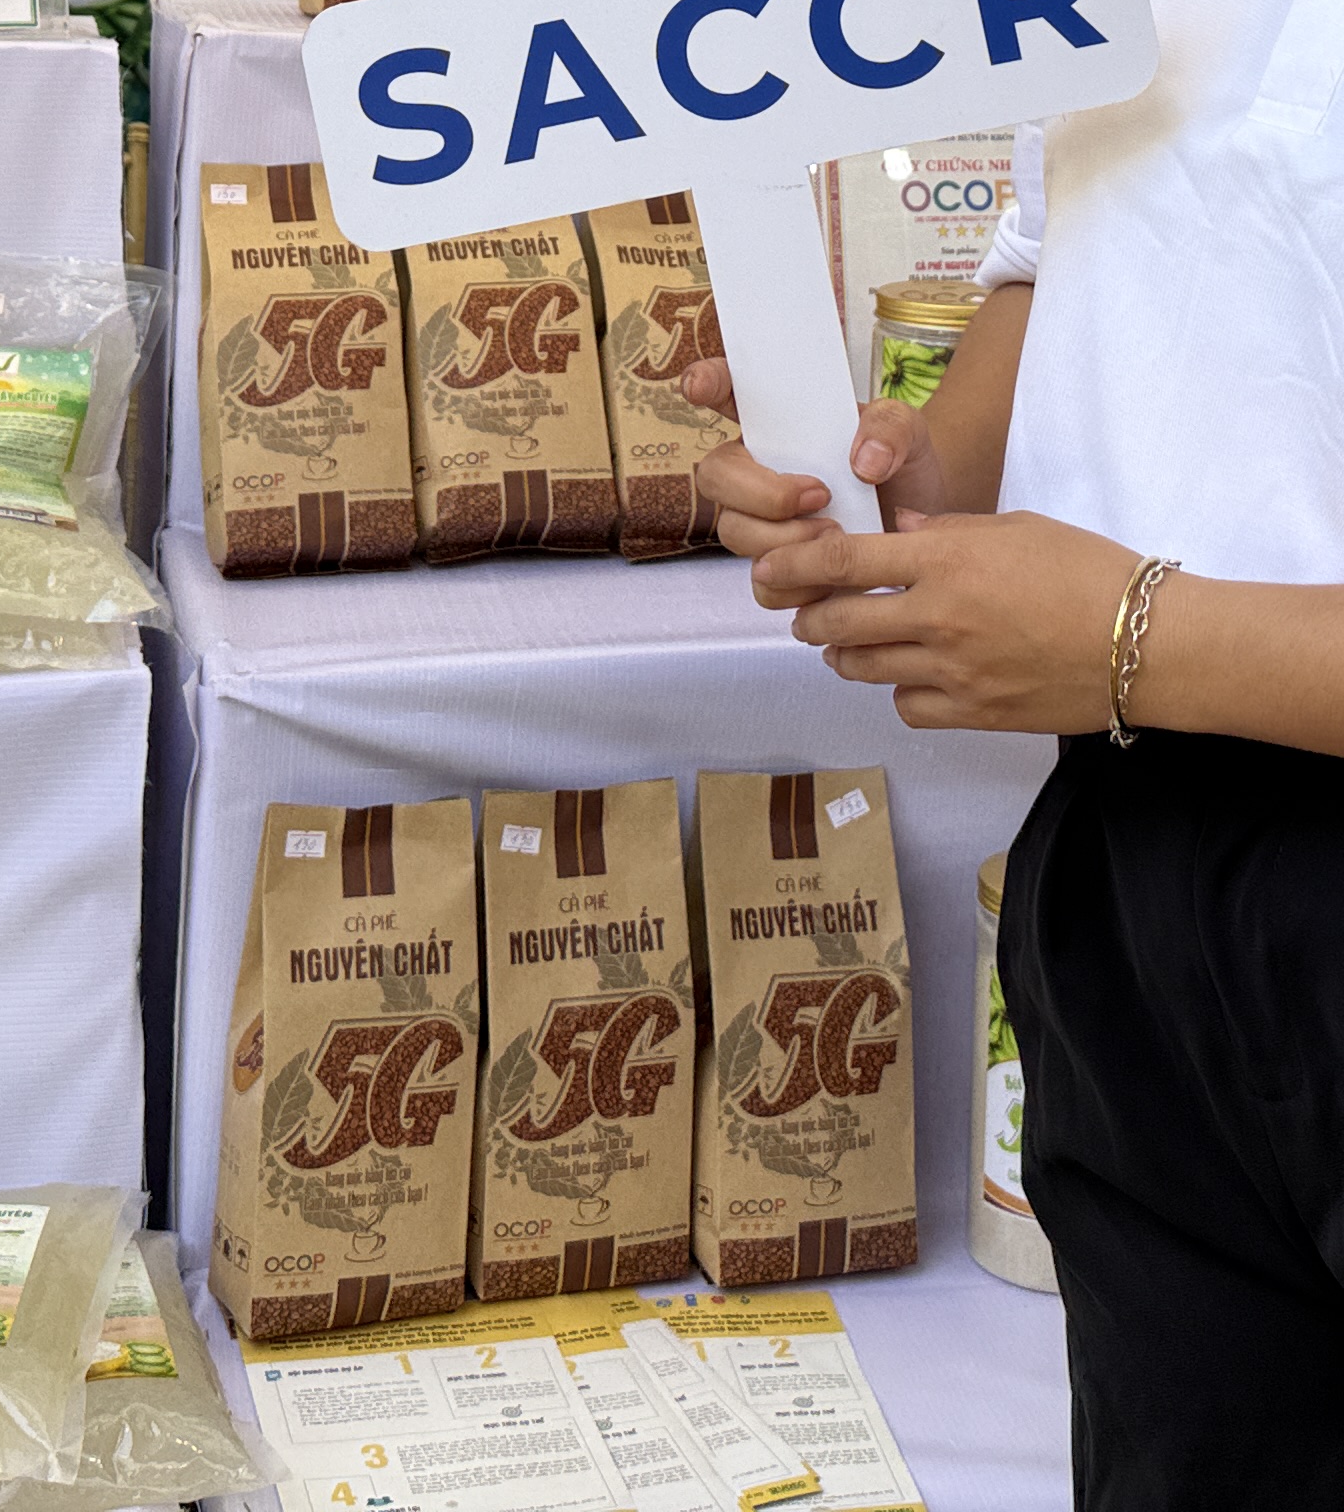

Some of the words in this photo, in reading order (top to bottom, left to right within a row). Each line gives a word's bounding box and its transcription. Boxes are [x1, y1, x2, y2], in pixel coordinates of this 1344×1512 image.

[925, 155, 984, 172] CHỨNG
[989, 159, 1012, 172] NH
[231, 238, 313, 269] NGUYÊN
[427, 236, 505, 263] NGUYÊN
[511, 230, 560, 258] CHẤT
[617, 241, 690, 267] NGUYÊN
[428, 278, 583, 390] 5G
[230, 287, 389, 408] 5G
[440, 450, 490, 469] OCOP
[631, 444, 682, 458] OCOP
[232, 472, 286, 490] OCOP
[559, 892, 579, 913] CÀ
[584, 891, 610, 911] PHÊ
[730, 898, 815, 941] NGUYÊN
[823, 887, 878, 935] CHẤT
[344, 912, 365, 932] CÀ
[370, 912, 399, 932] PHÊ
[508, 917, 599, 965] NGUYÊN
[607, 905, 666, 955] CHẤT
[289, 936, 385, 984] NGUYÊN
[393, 927, 454, 977] CHẤT
[731, 967, 902, 1118] 5G
[493, 989, 681, 1143] 5G
[267, 1012, 465, 1170] 5G
[728, 1197, 787, 1216] OCOP
[494, 1219, 553, 1238] OCOP
[264, 1253, 326, 1273] OCOP
[474, 1346, 502, 1369] 2
[768, 1338, 795, 1358] 2
[394, 1352, 414, 1375] 1
[360, 1443, 389, 1469] 3
[331, 1481, 358, 1507] 4
